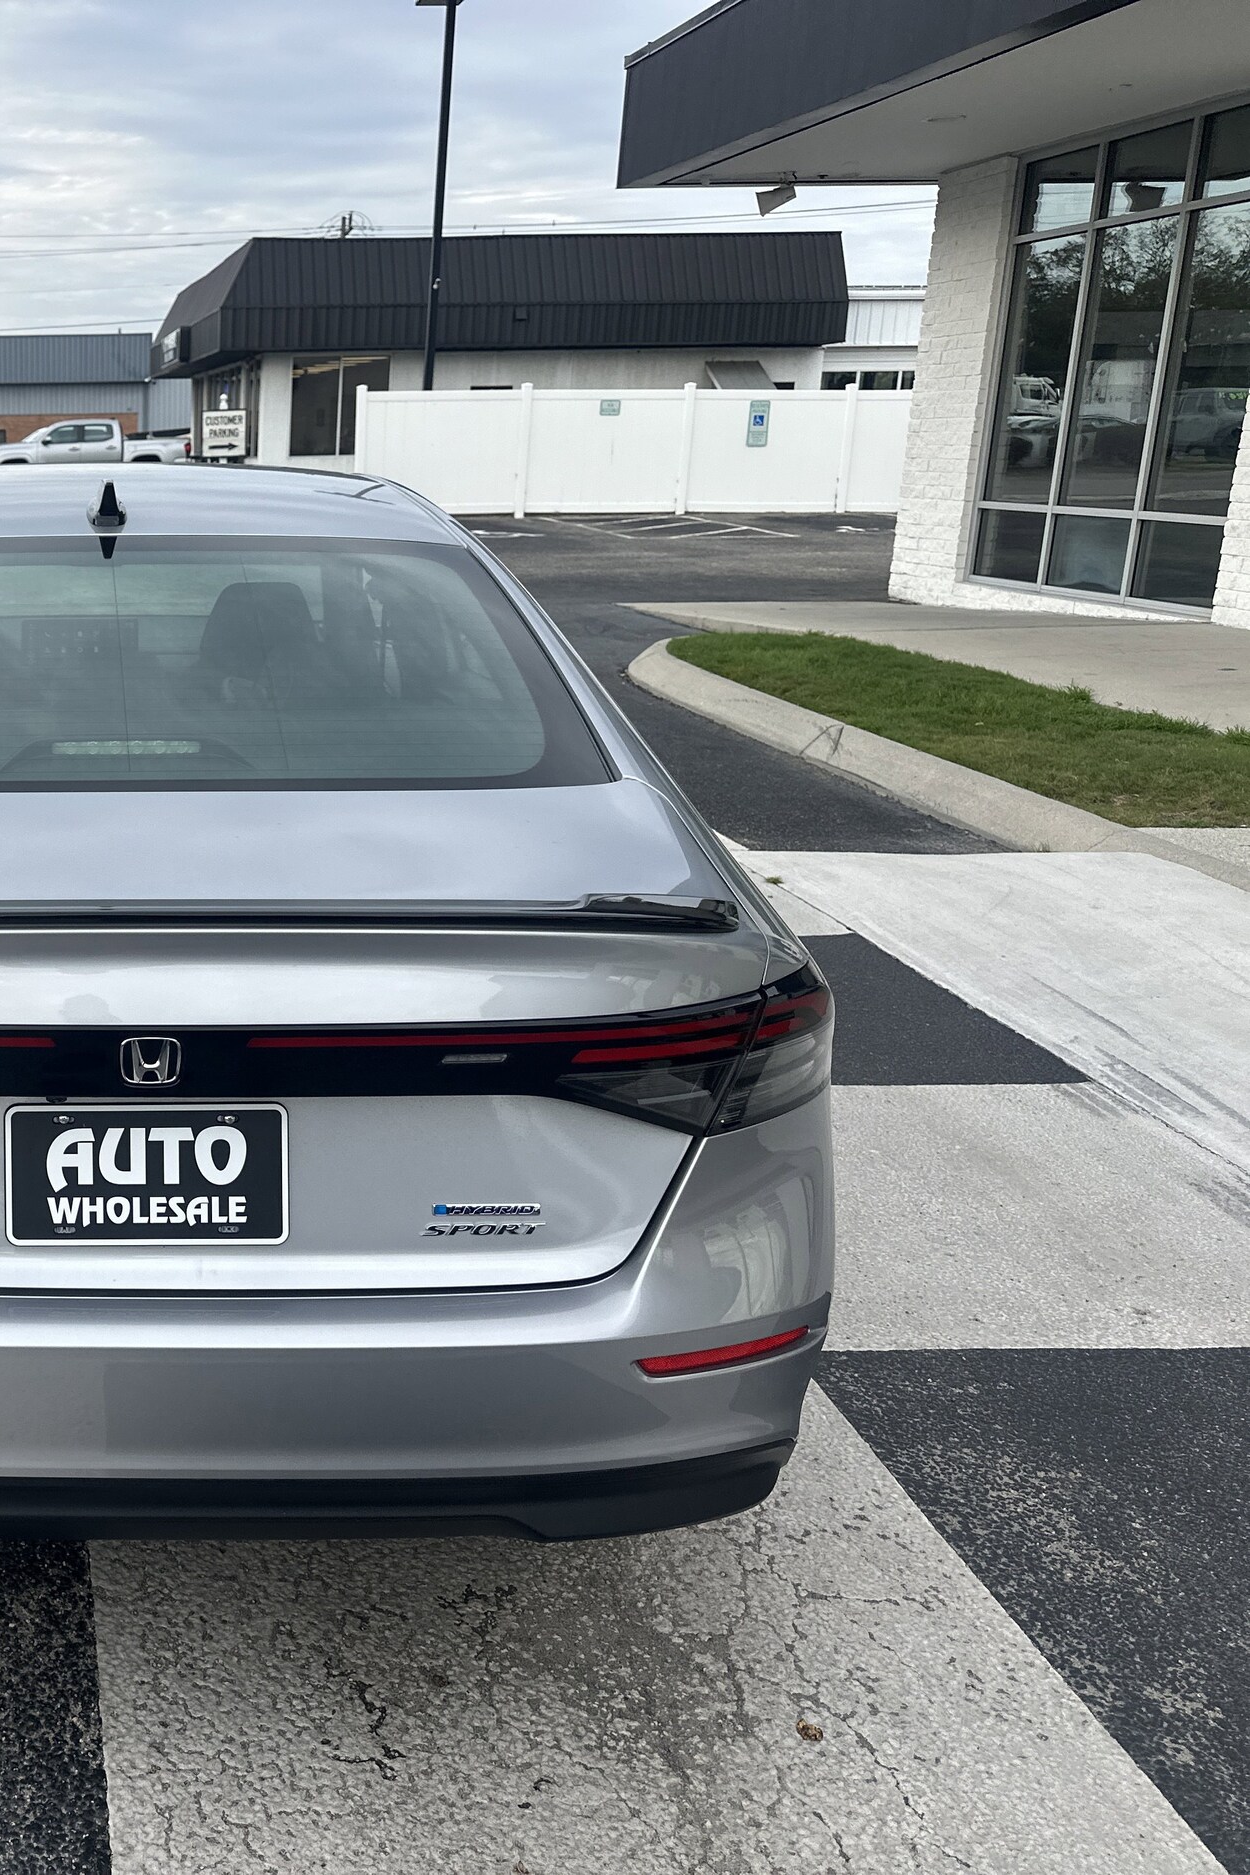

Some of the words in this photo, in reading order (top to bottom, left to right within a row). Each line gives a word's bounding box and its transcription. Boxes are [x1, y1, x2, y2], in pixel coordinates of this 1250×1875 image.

[205, 415, 243, 426] CUSTOMER
[209, 428, 239, 438] PARKING
[46, 1125, 247, 1193] AUTO
[46, 1196, 248, 1228] WHOLESALE
[449, 1205, 537, 1216] HYBRID
[420, 1221, 547, 1237] SPORT
